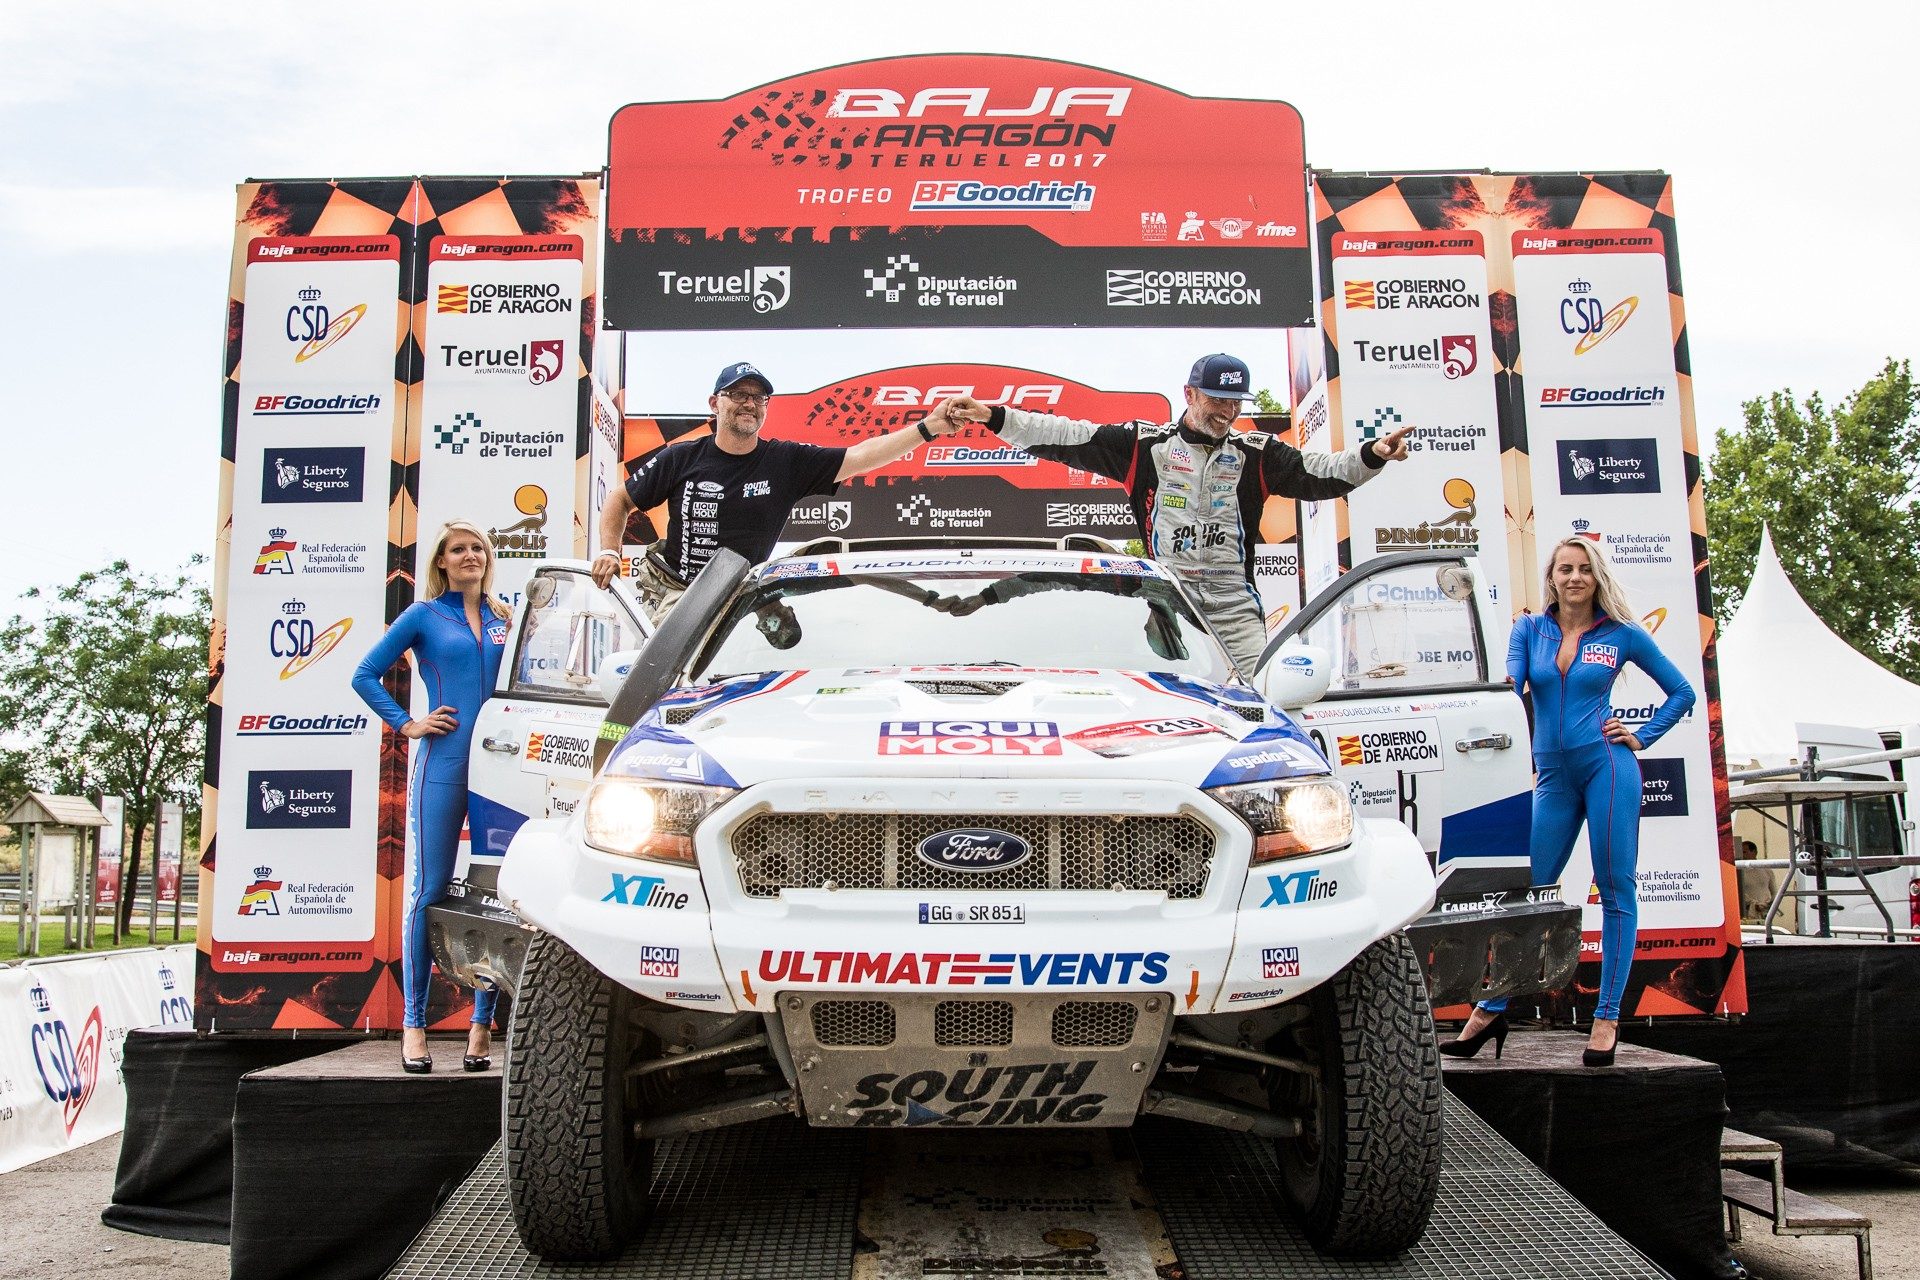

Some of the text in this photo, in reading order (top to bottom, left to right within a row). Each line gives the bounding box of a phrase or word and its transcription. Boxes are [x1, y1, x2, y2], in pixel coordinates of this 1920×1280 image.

[826, 87, 1132, 118] BAJA
[873, 119, 1117, 147] ARAGÓN
[870, 154, 1107, 167] TERUEL 2017
[798, 183, 1092, 204] TROFEO BFGoodrich
[258, 242, 390, 258] bajaaragon.com
[440, 242, 573, 257] bajaaragon.com
[1342, 237, 1473, 252] bajaaragon.com
[1522, 235, 1653, 251] bajaaragon.com
[658, 269, 750, 294] Teruel
[918, 276, 1017, 291] Diputación
[1145, 271, 1247, 287] GOBIERNO
[1376, 279, 1465, 293] GOBIERNO
[470, 284, 560, 298] GOBIERNO
[1145, 289, 1261, 305] DE ARAGON
[469, 299, 572, 313] DE ARAGON
[918, 292, 1004, 306] de Teruel
[1376, 295, 1479, 309] DE ARAGON
[287, 305, 329, 341] CSD
[1561, 298, 1603, 334] CSD
[441, 344, 527, 367] Teruel
[1354, 338, 1439, 362] Teruel
[1541, 386, 1665, 402] BFGoodrich
[254, 395, 381, 411] BFGoodrich
[480, 431, 564, 445] Diputación
[1427, 438, 1476, 452] Teruel
[480, 445, 552, 458] de Teruel
[1598, 457, 1642, 471] Liberty
[304, 465, 348, 478] Liberty
[1599, 469, 1646, 482] Seguros
[302, 479, 349, 492] Seguros
[743, 480, 769, 491] SOUTH
[1163, 495, 1187, 503] MANN
[1163, 501, 1185, 509] FILTER
[693, 510, 717, 518] MOLY
[694, 503, 718, 511] LIQUI
[930, 508, 991, 519] Diputación
[930, 518, 983, 528] de Teruel
[1070, 515, 1085, 526] DE
[488, 527, 549, 550] ÓPOLIS
[1375, 521, 1479, 544] DINÓPOLIS
[1607, 534, 1671, 544] Real Federación
[302, 542, 366, 553] Real Federación
[1615, 544, 1664, 555] Española de
[308, 553, 358, 564] Española de
[1255, 555, 1297, 565] BIERNO
[302, 564, 365, 574] Automovilismo
[270, 619, 315, 658] CSD
[1584, 645, 1616, 657] LIQUI
[1285, 656, 1307, 665] Ford
[1584, 654, 1616, 668] MOLY
[239, 715, 367, 731] BFGoodrich
[890, 722, 1050, 737] LIQUI
[1145, 719, 1205, 734] 219
[544, 734, 589, 753] GOBIERNO
[887, 737, 1059, 755] MOLY
[1361, 730, 1427, 749] GOBIERNO
[541, 749, 593, 769] DE ARAGON
[1229, 750, 1290, 770] agados
[1364, 744, 1438, 764] DE ARAGON
[1362, 786, 1397, 798] Diputación
[1643, 779, 1669, 791] erty
[289, 790, 334, 804] Liberty
[1362, 794, 1392, 806] de Teruel
[1641, 793, 1673, 806] guros
[288, 804, 336, 817] Seguros
[942, 834, 1006, 860] Ford
[1654, 870, 1699, 880] Federación
[288, 882, 354, 893] Real Federación
[601, 873, 688, 910] XTline
[1260, 869, 1338, 908] XTline
[1642, 881, 1692, 891] Española de
[295, 894, 346, 905] Española de
[1637, 892, 1700, 903] Automovilismo
[288, 905, 353, 915] Automovilismo
[932, 906, 952, 920] GG
[222, 950, 362, 965] bajaaragon.com
[642, 947, 679, 964] LIQUI
[1263, 947, 1297, 964] LIQUI
[641, 962, 678, 977] MOLY
[1263, 962, 1299, 978] MOLY
[665, 991, 721, 1000] BFGoodrich
[1229, 988, 1283, 1000] BFGoodrich
[32, 1020, 81, 1102] CSD
[845, 1060, 1098, 1108] SOUTH
